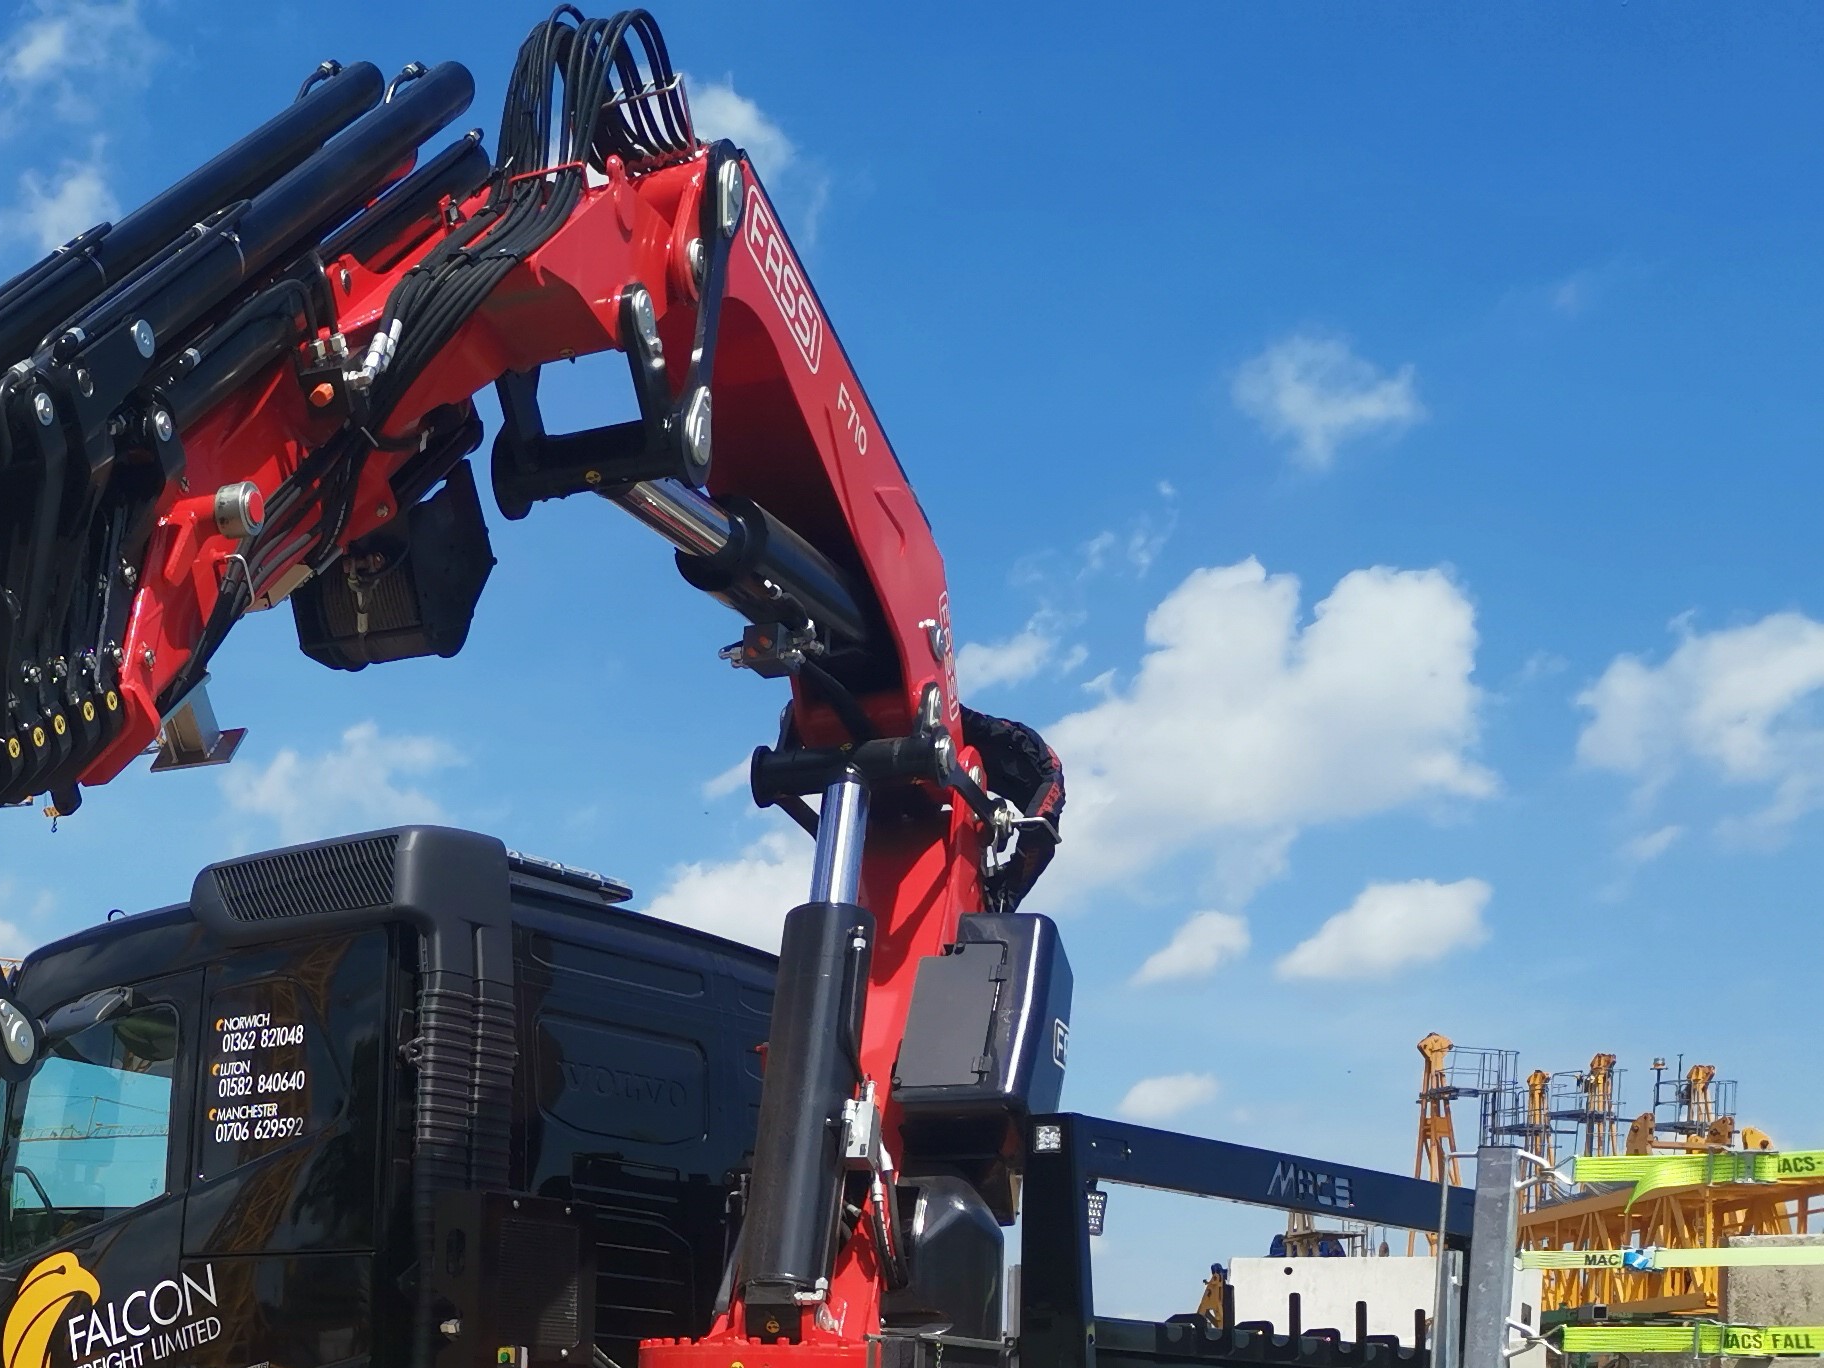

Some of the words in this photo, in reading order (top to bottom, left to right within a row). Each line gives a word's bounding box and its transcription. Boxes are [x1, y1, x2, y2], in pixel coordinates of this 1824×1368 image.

[750, 205, 819, 363] FASSI
[837, 381, 868, 456] F710
[223, 1013, 270, 1032] NORWICH
[222, 1031, 256, 1052] 01362
[260, 1025, 304, 1047] 821048
[220, 1060, 250, 1076] LUTON
[218, 1077, 253, 1098] 01582
[257, 1071, 305, 1093] 840640
[216, 1103, 278, 1121] MANCHESTER
[215, 1123, 249, 1142] 01706
[254, 1117, 303, 1139] 629592
[68, 1263, 217, 1361] FALCON
[151, 1316, 221, 1360] LIMITED
[1772, 1334, 1815, 1349] FALL
